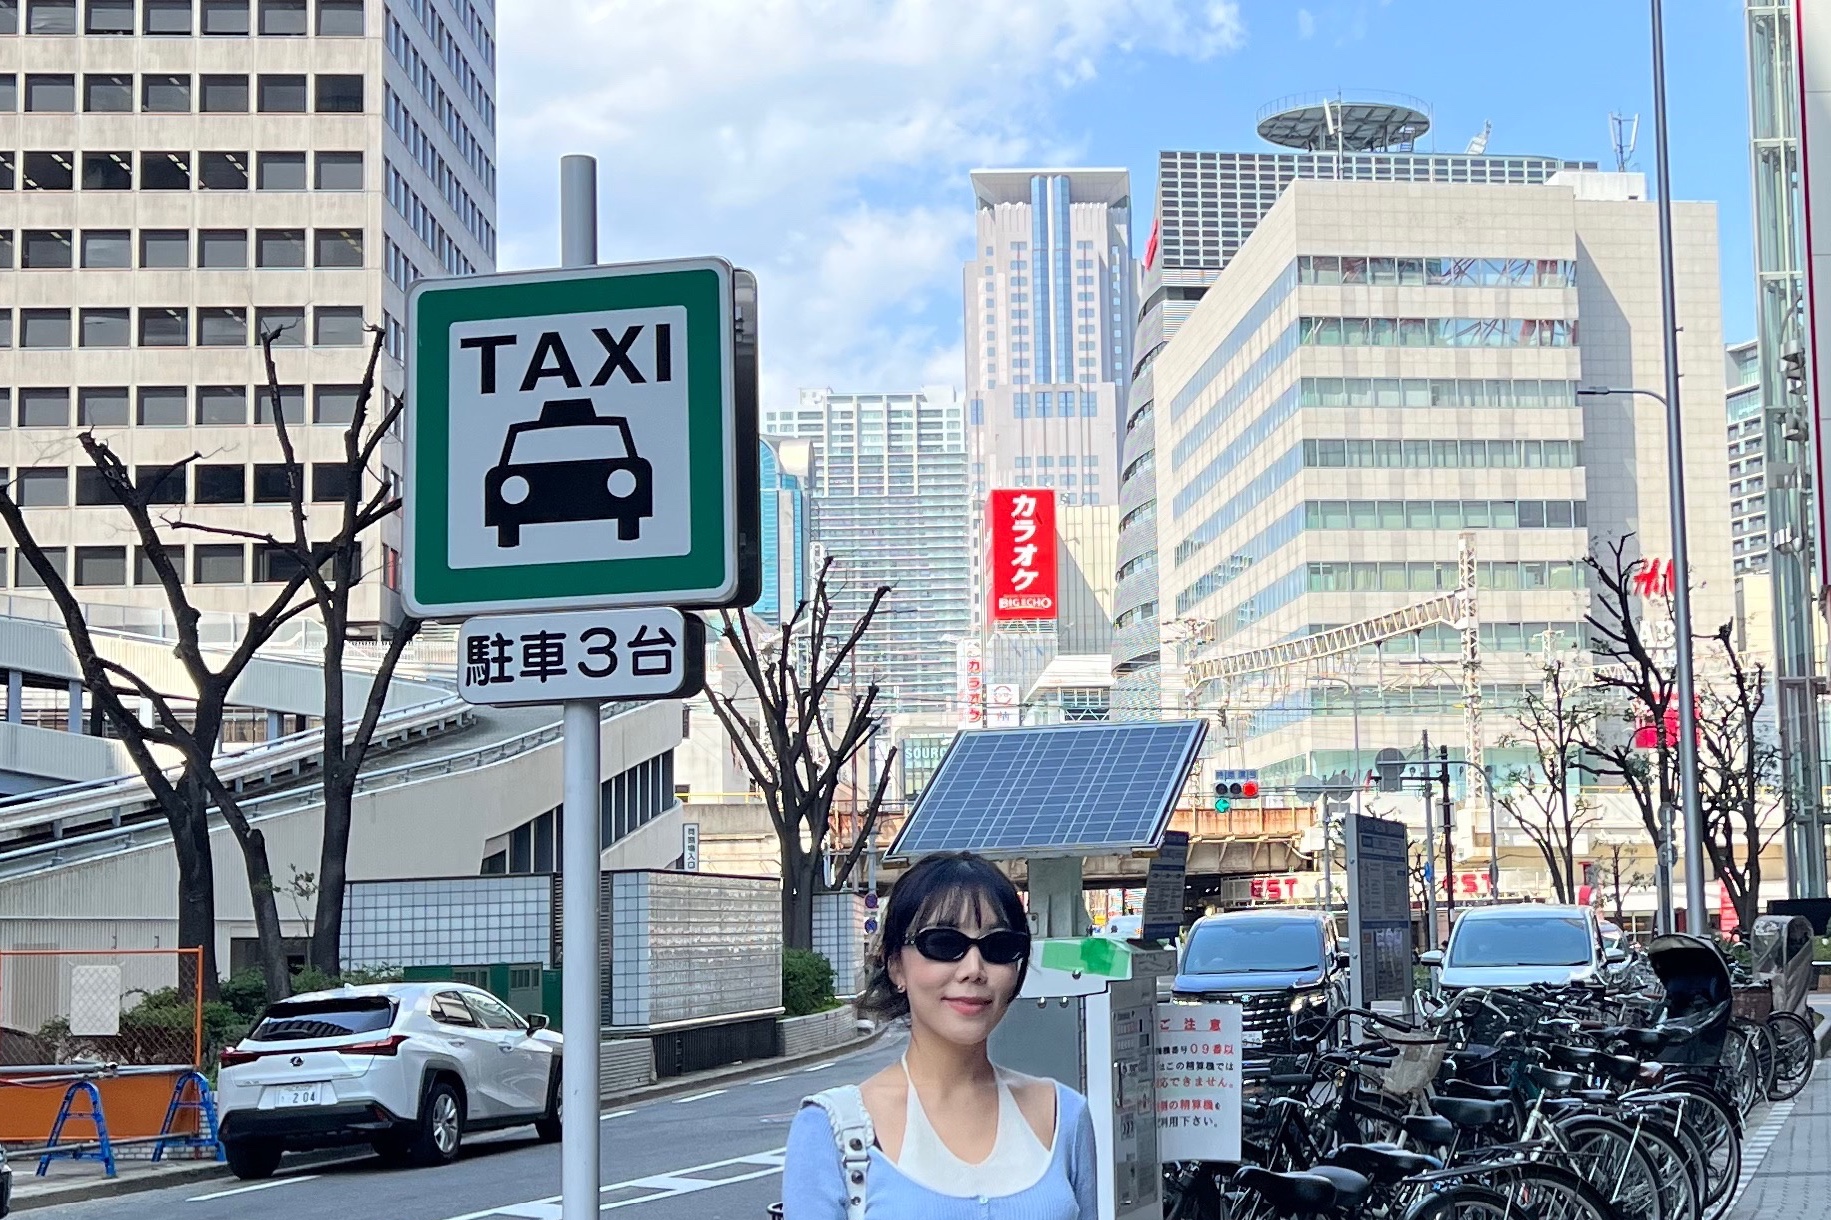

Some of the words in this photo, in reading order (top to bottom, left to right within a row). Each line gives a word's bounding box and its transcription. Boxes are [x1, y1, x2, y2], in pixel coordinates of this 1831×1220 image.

[460, 323, 672, 394] TAXI
[1011, 494, 1039, 591] カラオケ
[998, 597, 1020, 609] BIG
[1021, 597, 1052, 609] ECHO
[465, 624, 677, 687] 駐車3台
[968, 660, 981, 722] カラオケ
[1250, 878, 1298, 899] EST
[1159, 1017, 1222, 1032] ご注意
[1156, 1075, 1234, 1089] 応できません。
[292, 1091, 315, 1103] 204
